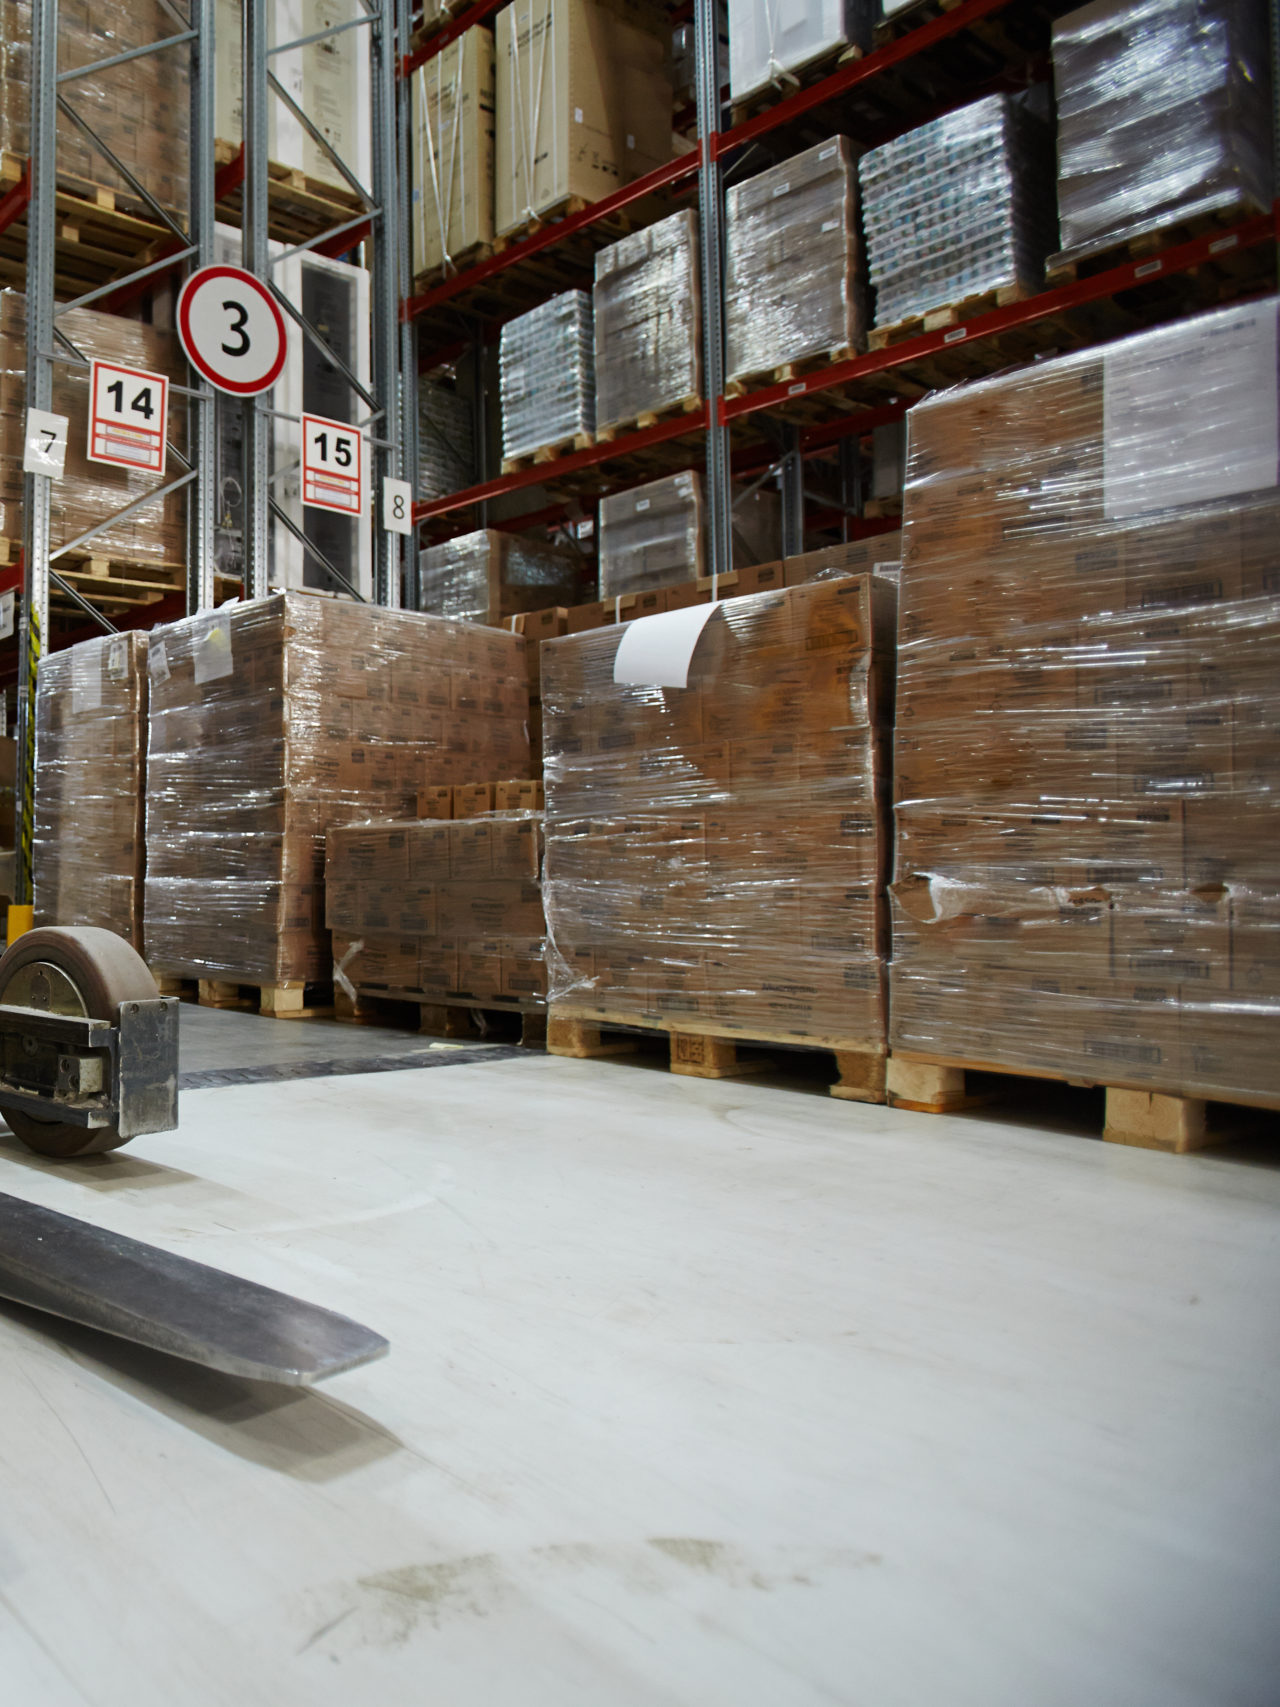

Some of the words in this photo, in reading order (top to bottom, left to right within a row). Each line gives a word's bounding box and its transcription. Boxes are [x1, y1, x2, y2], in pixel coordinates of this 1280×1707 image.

[222, 301, 250, 356] 3
[107, 380, 154, 420] 14
[40, 429, 57, 453] 7
[314, 432, 352, 467] 15
[393, 494, 405, 519] 8
